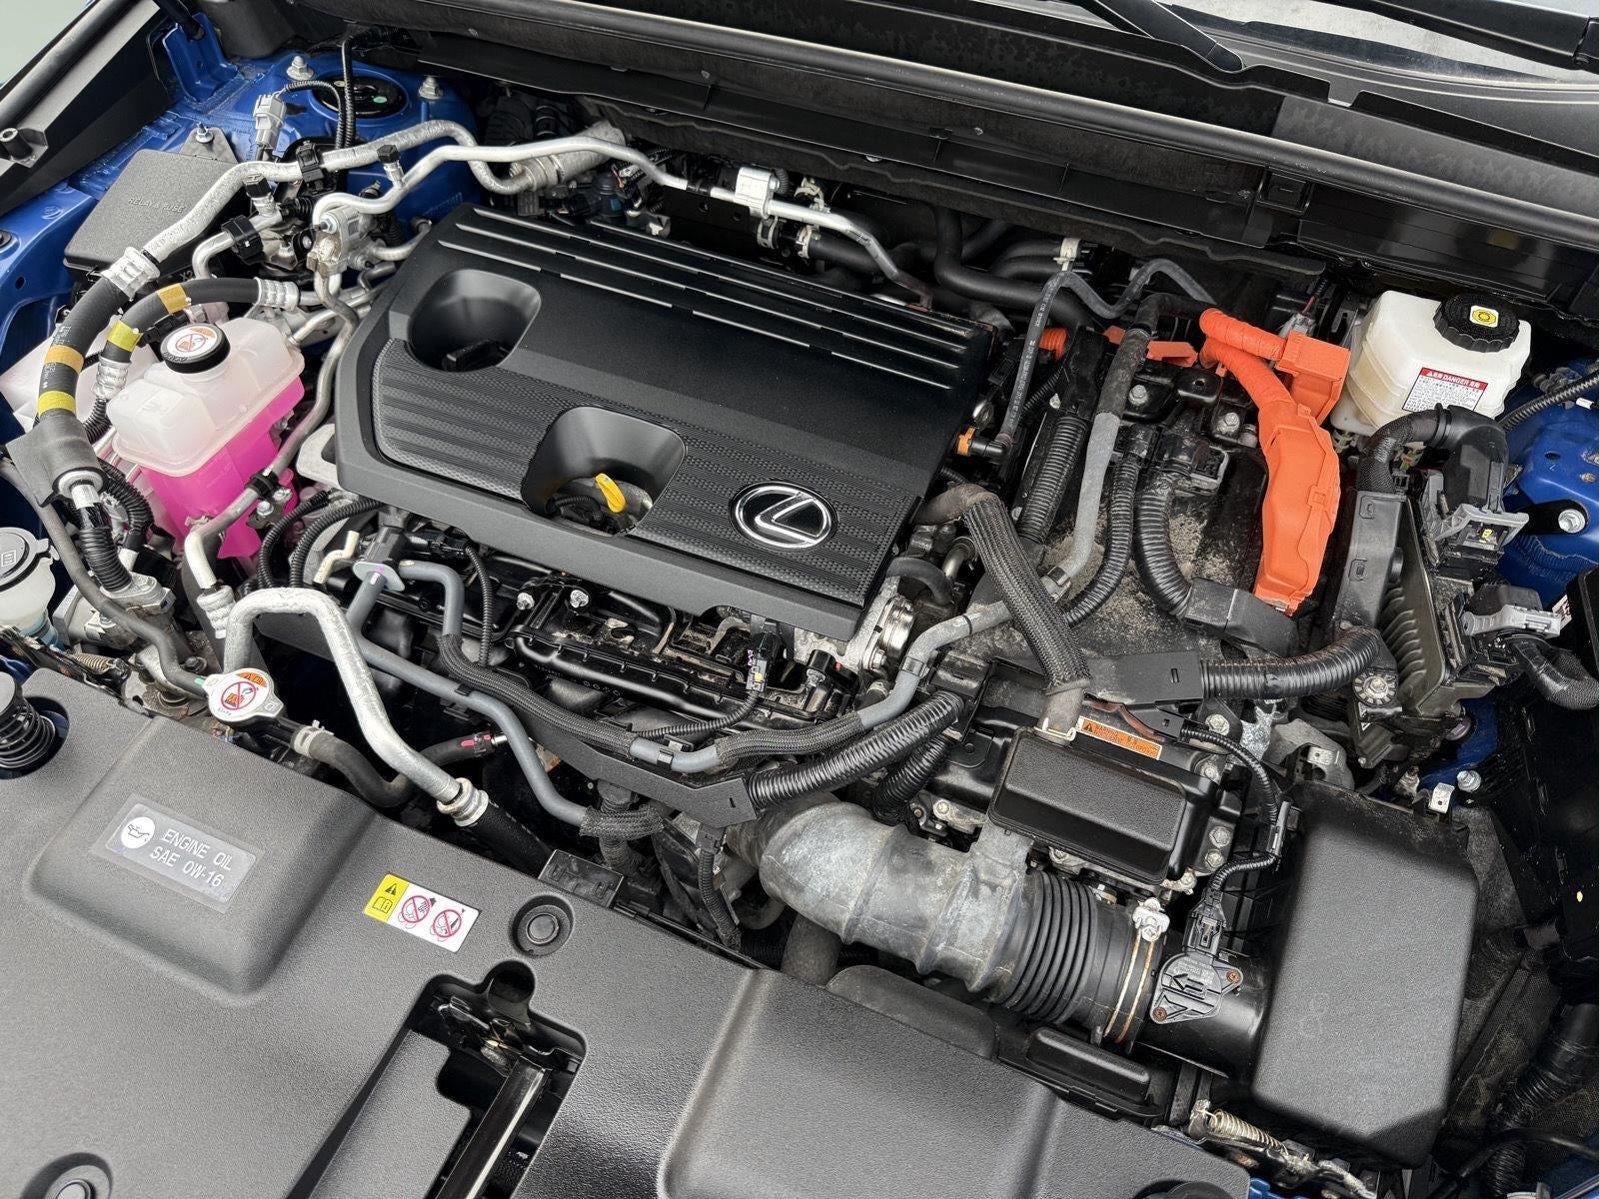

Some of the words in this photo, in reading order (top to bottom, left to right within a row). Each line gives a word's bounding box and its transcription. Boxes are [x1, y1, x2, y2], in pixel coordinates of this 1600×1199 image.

[1443, 373, 1470, 387] DANGER
[149, 846, 181, 868] SAE
[182, 860, 225, 887] 0W-16
[162, 828, 211, 859] ENGINE
[212, 851, 234, 871] OIL
